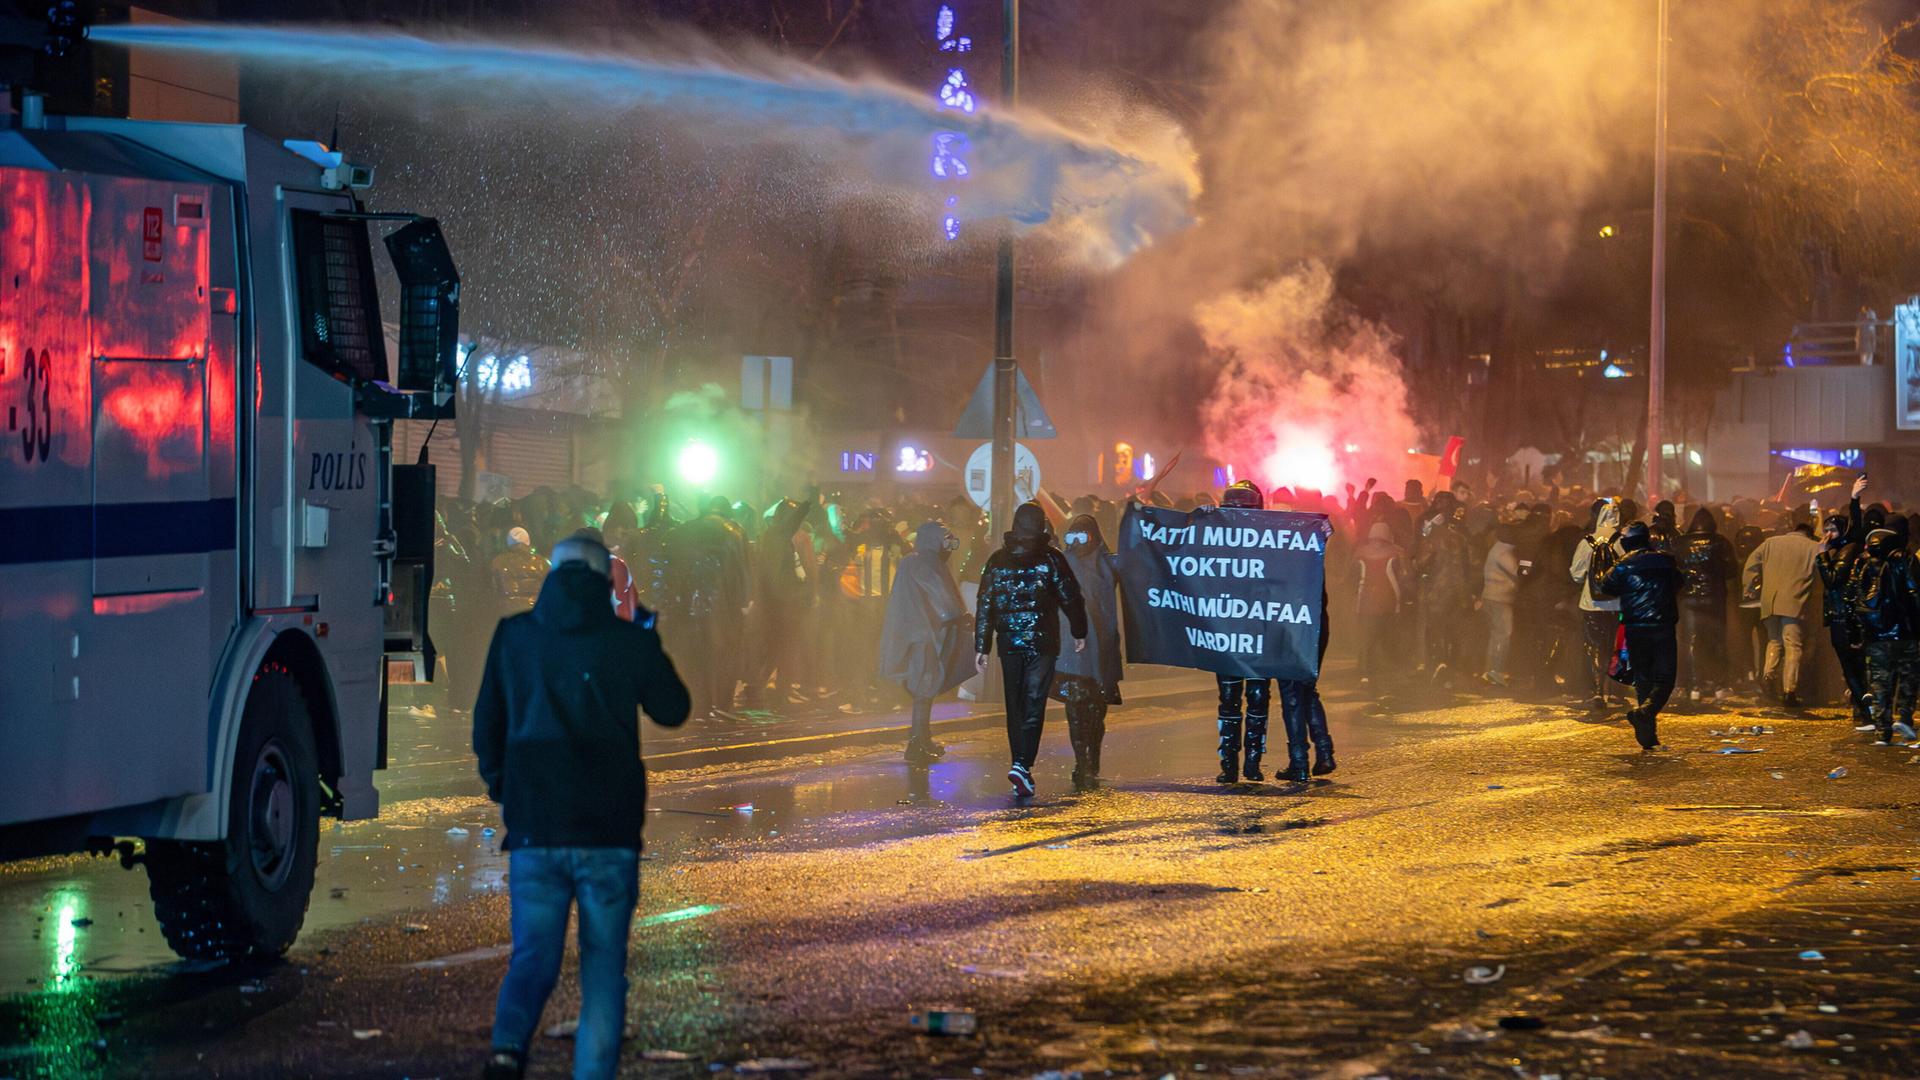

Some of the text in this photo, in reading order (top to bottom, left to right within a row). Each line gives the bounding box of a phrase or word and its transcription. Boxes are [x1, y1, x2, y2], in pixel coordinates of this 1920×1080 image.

[146, 214, 161, 238] 112
[308, 440, 367, 491] POLİS
[1139, 519, 1321, 552] HATTI MUDAFAA
[1166, 556, 1265, 579] YOKTUR
[1147, 588, 1313, 625] SATHI MÜDAFAA
[1185, 627, 1263, 655] VARDIR!
